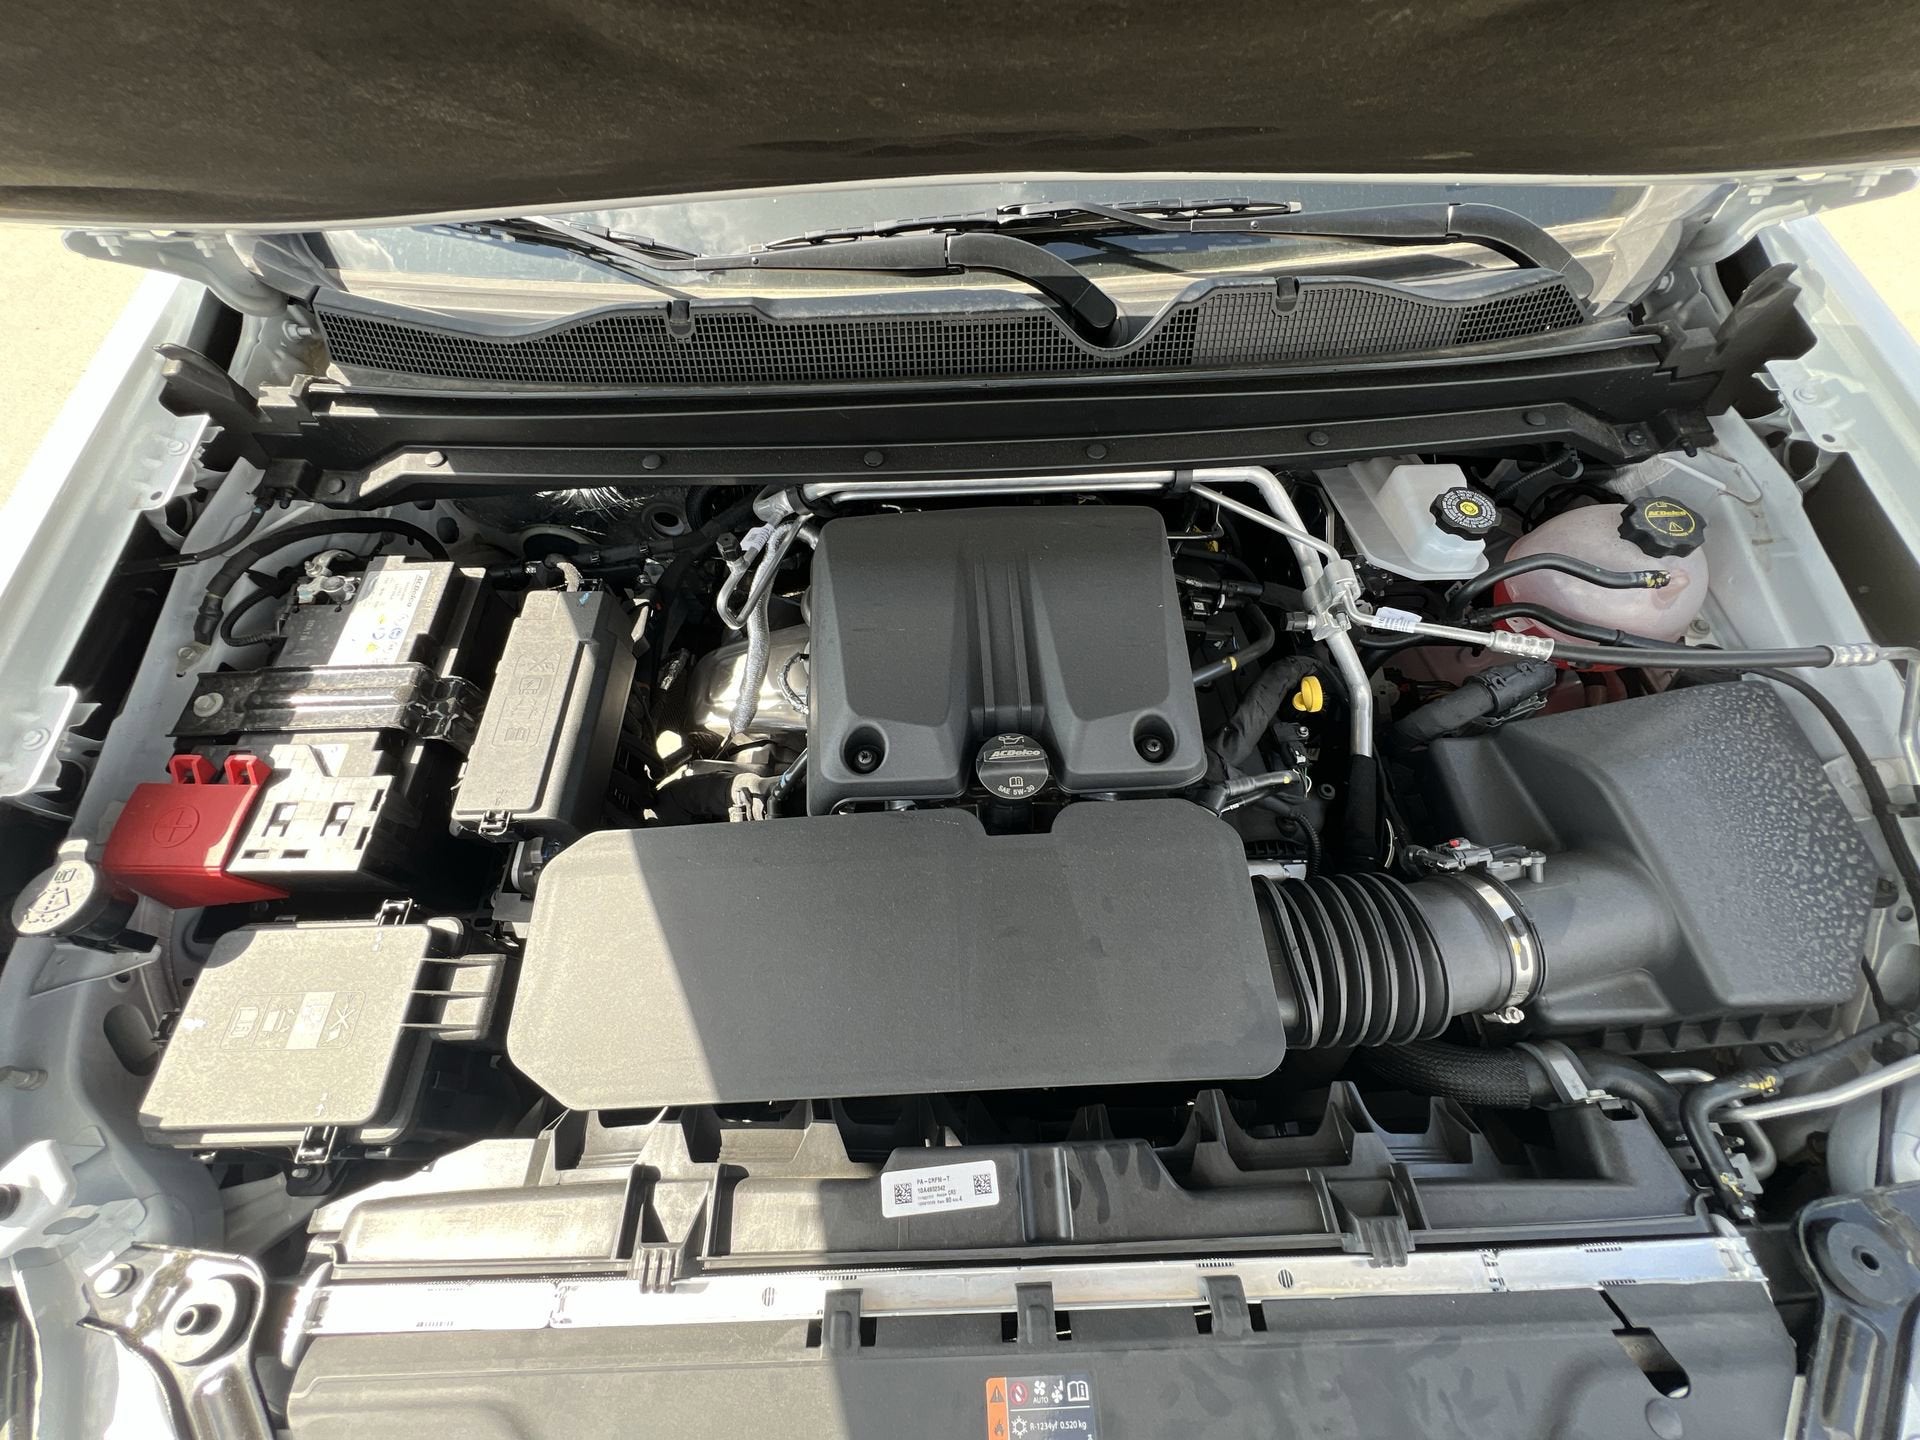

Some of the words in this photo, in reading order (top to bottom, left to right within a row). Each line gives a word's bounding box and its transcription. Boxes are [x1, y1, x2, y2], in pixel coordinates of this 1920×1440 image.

[990, 749, 1041, 758] ACDelco
[997, 785, 1011, 795] SAE
[1013, 784, 1035, 796] 5W-30
[1033, 1396, 1049, 1404] AUTO
[1029, 1420, 1058, 1431] R-1234yf
[1059, 1420, 1078, 1430] 0.520
[1078, 1419, 1087, 1431] kg
